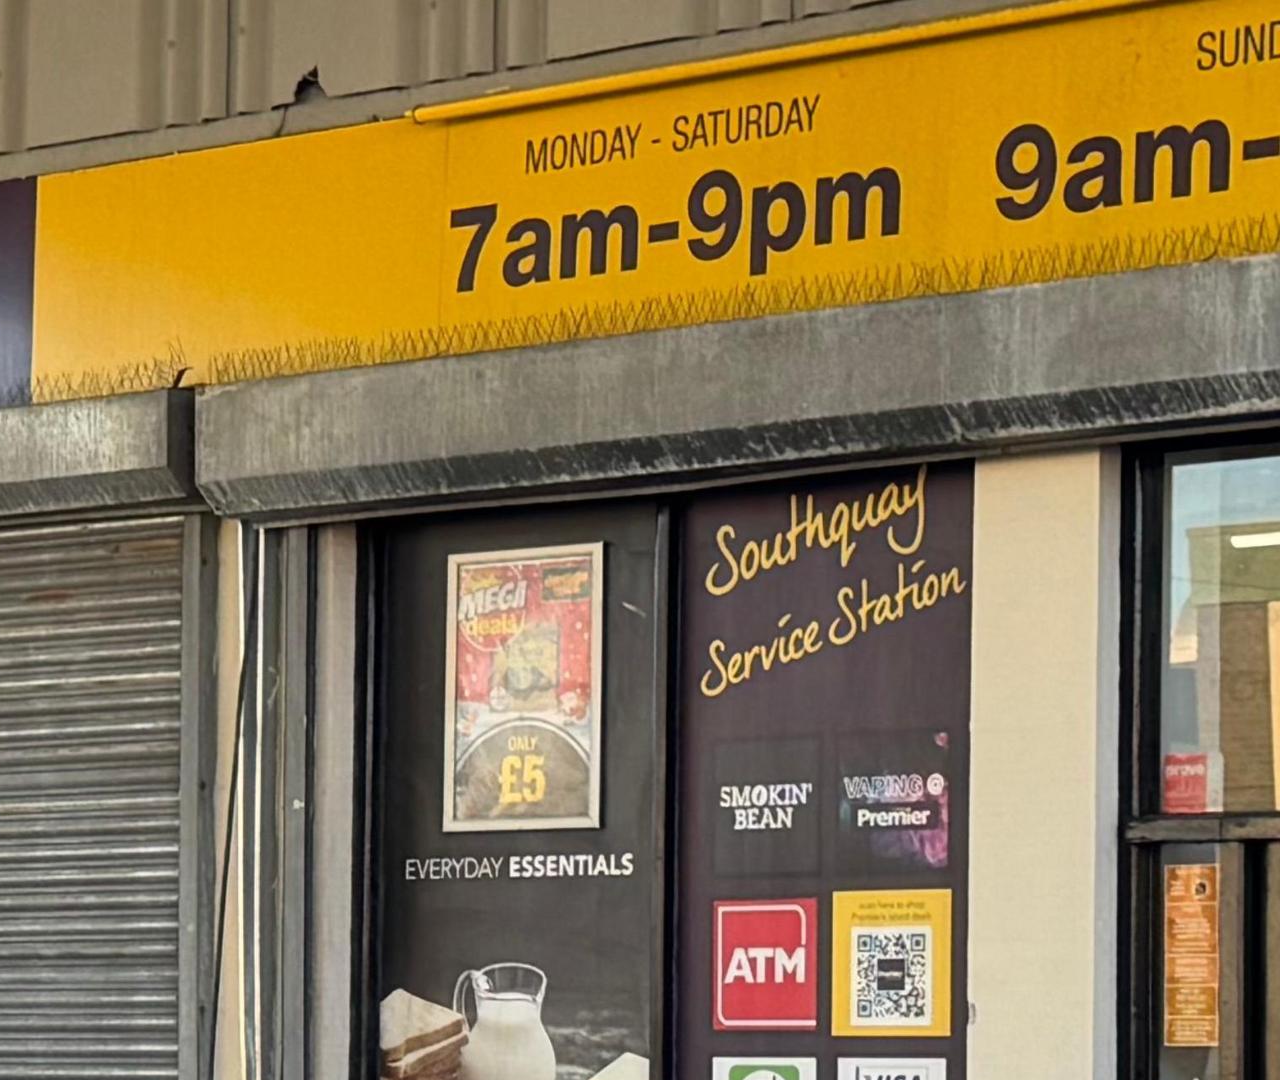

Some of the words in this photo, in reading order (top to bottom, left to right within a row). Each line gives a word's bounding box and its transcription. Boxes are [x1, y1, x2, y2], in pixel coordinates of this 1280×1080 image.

[524, 123, 641, 176] MONDAY
[672, 93, 820, 153] SATURDAY
[449, 165, 902, 292] 7am-9pm
[706, 464, 927, 596] Southquay
[458, 580, 527, 620] MEGA
[467, 613, 519, 636] deals
[700, 612, 821, 697] Service
[829, 560, 967, 645] Station
[508, 735, 538, 750] ONLY
[499, 754, 546, 804] £5
[720, 783, 813, 807] SMOKIN'
[843, 774, 924, 799] VAPING
[926, 773, 945, 795] @
[733, 807, 794, 830] BEAN
[857, 807, 931, 827] Premier
[405, 856, 505, 880] EVERYDAY
[509, 852, 634, 877] ESSENTIALS
[724, 947, 806, 984] ATM
